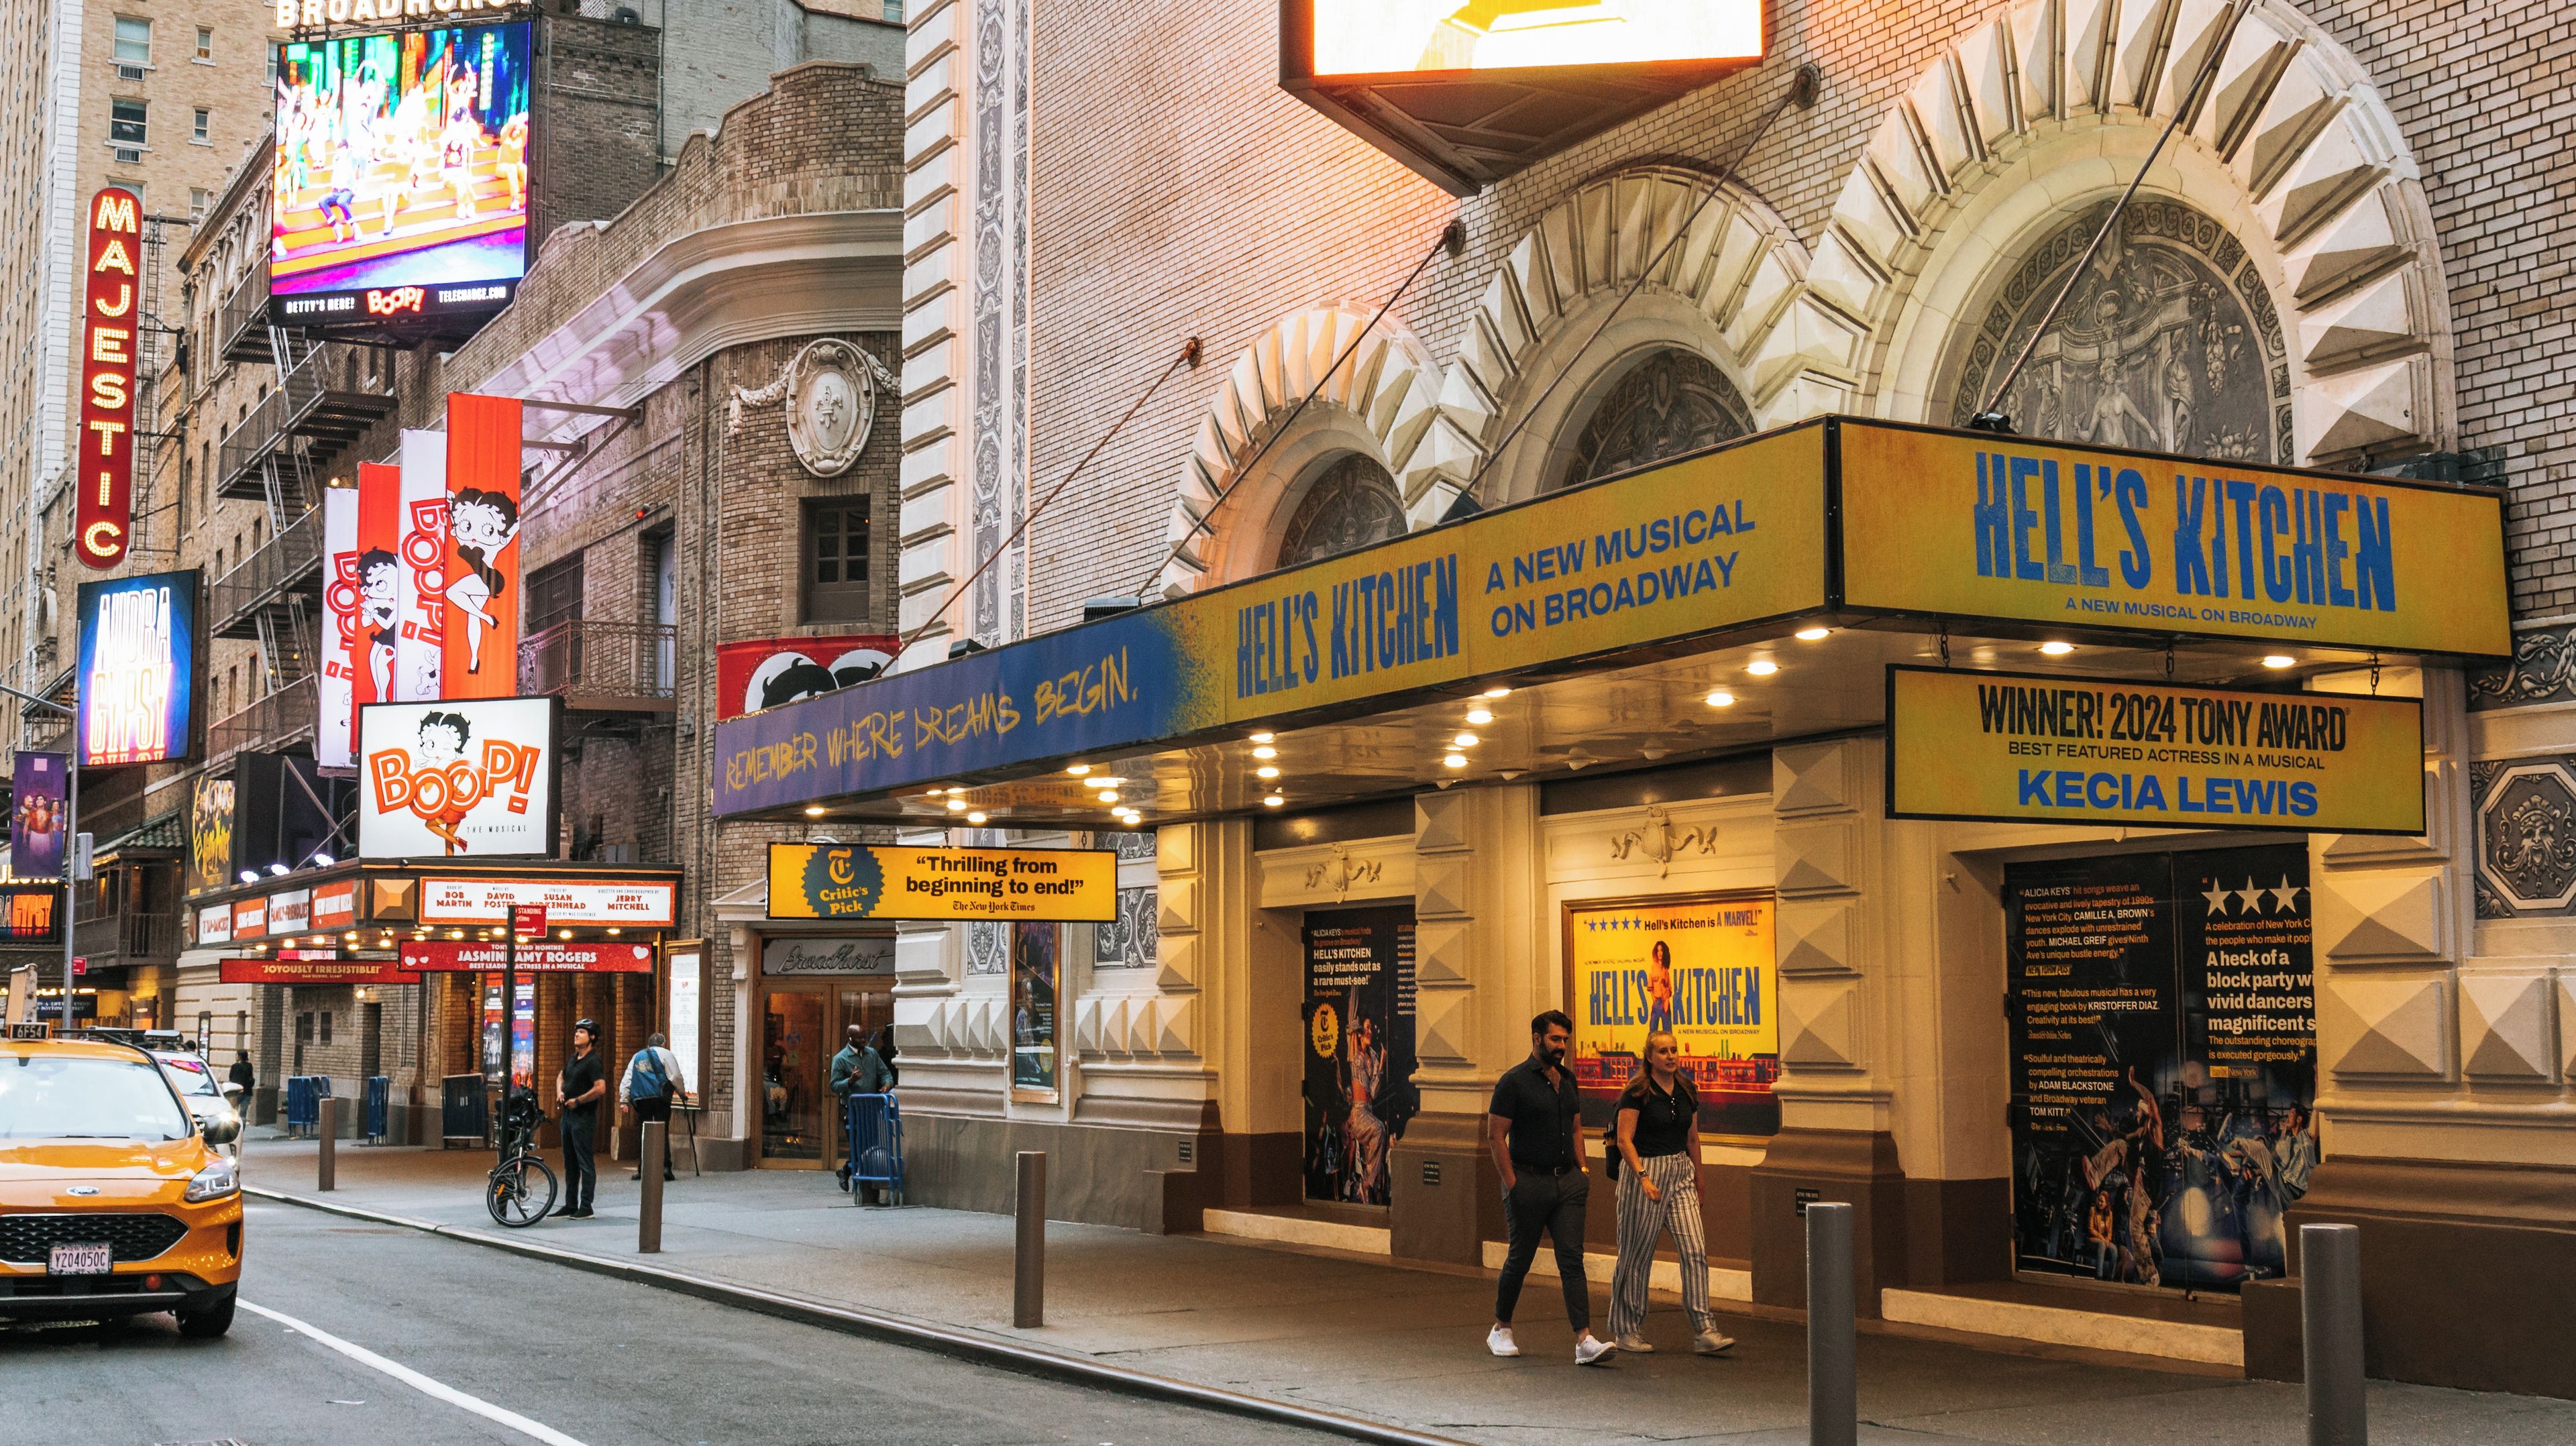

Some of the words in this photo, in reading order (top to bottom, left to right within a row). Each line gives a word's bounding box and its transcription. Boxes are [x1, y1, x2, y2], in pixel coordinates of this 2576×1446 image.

[276, 0, 535, 29] BROADH
[367, 286, 425, 316] BOOP!
[439, 286, 506, 303] TELECHARGE.COM
[286, 300, 325, 314] BETTY'S
[327, 297, 355, 311] HERE!
[85, 194, 137, 557] MAJESTIC
[1974, 452, 2151, 590] HELL'S
[2174, 475, 2396, 612] KITCHEN
[1485, 562, 1505, 594] A
[1513, 539, 1586, 587] NEW
[1595, 499, 1756, 567] MUSICAL
[1491, 600, 1535, 637] ON
[1545, 551, 1739, 626] BROADWAY
[2065, 597, 2077, 610] A
[2081, 599, 2120, 613] NEW
[2125, 602, 2197, 620] MUSICAL
[2201, 608, 2224, 622] ON
[2229, 610, 2317, 629] BROADWAY
[1237, 591, 1319, 698] HELL'S
[1331, 553, 1459, 680] KITCHEN
[725, 732, 818, 794] REMEMBER
[826, 710, 905, 767] WHERE
[915, 692, 1020, 752] DREAMS
[1034, 645, 1138, 726] BEGIN.
[1978, 684, 2104, 739] WINNER!
[2110, 693, 2176, 743] 2024
[2180, 697, 2253, 747] TONY
[2009, 742, 2052, 757] BEST
[2056, 744, 2143, 761] FEATURED
[2147, 749, 2220, 765] ACTRESS
[2224, 753, 2240, 766] IN
[2243, 754, 2255, 766] A
[2257, 755, 2325, 770] MUSICAL
[369, 739, 541, 820] BOOP!
[2018, 769, 2168, 812] KECIA
[2178, 776, 2318, 817] LEWIS
[489, 825, 526, 833] MUSICAL
[916, 856, 1008, 877] “Thrilling
[1012, 857, 1057, 874] from
[819, 887, 869, 901] Critic's
[906, 877, 1004, 897] beginning
[1009, 879, 1028, 893] to
[1034, 879, 1083, 895] end!”
[13, 894, 53, 927] GYPSY
[437, 899, 472, 907] MARTIN
[829, 900, 863, 915] Pick
[953, 900, 968, 911] The
[969, 901, 986, 910] New
[989, 901, 1009, 913] York
[1010, 901, 1035, 911] Times
[2025, 901, 2059, 911] evocative
[2092, 898, 2121, 907] tapestry
[2131, 896, 2154, 905] 1990s
[1644, 920, 1668, 931] Hell's
[1670, 917, 1706, 930] Kitchen
[1707, 917, 1715, 928] is
[1717, 912, 1721, 926] A
[2025, 914, 2041, 923] New
[2041, 913, 2057, 922] York
[2074, 910, 2106, 921] CAMILLE
[2025, 926, 2051, 935] dances
[2052, 925, 2079, 936] explode
[2080, 924, 2095, 933] with
[2096, 922, 2142, 932] unrestrained
[2212, 921, 2255, 930] celebration
[2266, 920, 2284, 929] New
[2284, 919, 2302, 928] York
[2049, 937, 2082, 946] MICHAEL
[2084, 936, 2106, 945] GREIF
[2219, 936, 2245, 946] people
[2264, 934, 2286, 944] make
[515, 952, 542, 962] AMY
[547, 952, 596, 962] ROGERS
[777, 943, 894, 973] Broadhurst
[1313, 949, 1338, 959] HELL'S
[1338, 948, 1371, 958] KITCHEN
[2047, 950, 2070, 960] unique
[2071, 949, 2092, 958] bustle
[2206, 951, 2218, 966] A
[2220, 950, 2259, 966] heck
[2261, 949, 2277, 966] of
[2279, 952, 2290, 965] a
[1313, 962, 1334, 975] easily
[1335, 961, 1358, 972] stands
[1359, 961, 1371, 971] out
[1372, 962, 1381, 971] as
[1319, 978, 1333, 986] rare
[2207, 971, 2251, 988] block
[2253, 971, 2294, 991] party
[1589, 969, 1649, 1025] HELL'S
[1672, 966, 1760, 1025] KITCHEN
[2059, 988, 2089, 997] fabulous
[2090, 988, 2118, 997] musical
[2119, 987, 2133, 996] has
[2140, 989, 2156, 998] very
[2027, 1002, 2059, 1013] engaging
[2060, 1001, 2077, 1010] book
[2088, 1001, 2137, 1011] KRISTOFFER
[2207, 993, 2244, 1009] vivid
[2246, 993, 2313, 1009] dancers
[2027, 1015, 2059, 1025] Creativity
[2208, 1014, 2305, 1035] magnificent
[17, 1025, 42, 1038] 6F54
[1321, 1043, 1332, 1051] Pick
[2208, 1036, 2225, 1045] The
[2224, 1036, 2271, 1047] outstanding
[2068, 1054, 2106, 1065] theatrically
[2217, 1050, 2252, 1060] executed
[2029, 1068, 2067, 1078] compelling
[2068, 1068, 2118, 1078] orchestrations
[2039, 1081, 2061, 1090] ADAM
[2062, 1081, 2114, 1091] BLACKSTONE
[2043, 1095, 2078, 1105] Broadway
[2080, 1097, 2106, 1105] veteran
[2030, 1107, 2046, 1116] TOM
[55, 1252, 106, 1268] Y204050C
